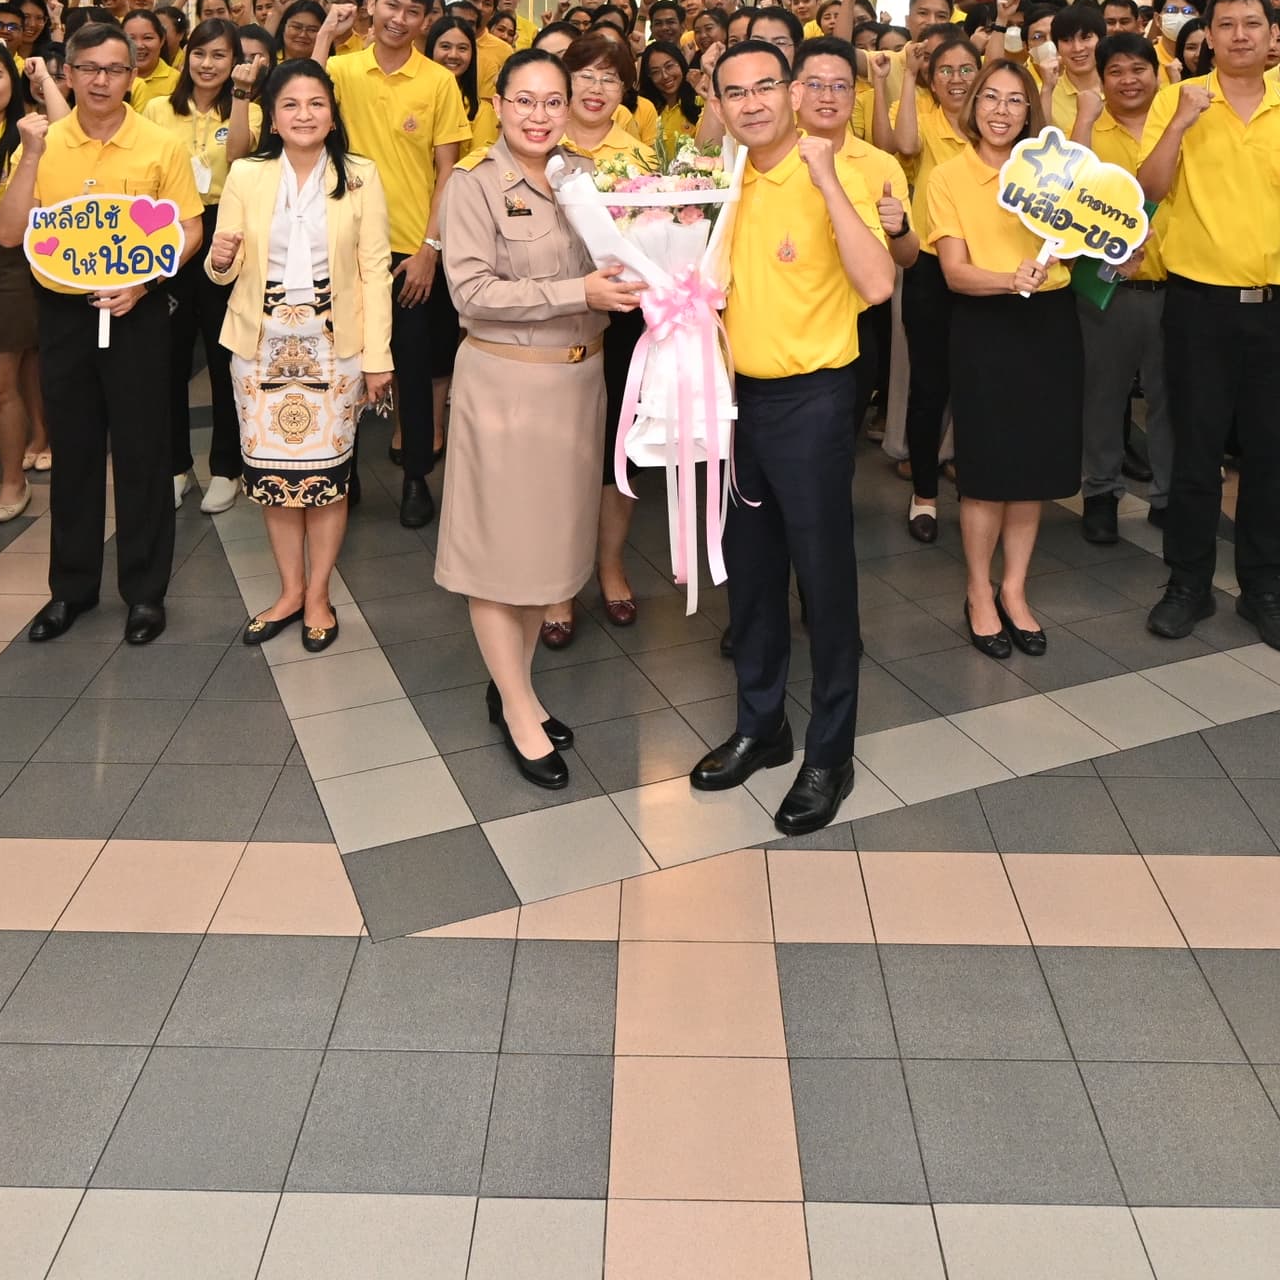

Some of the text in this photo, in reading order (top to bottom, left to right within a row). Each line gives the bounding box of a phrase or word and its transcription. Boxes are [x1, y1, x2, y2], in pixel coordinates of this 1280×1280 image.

[32, 201, 121, 230] เหลือใช้
[1076, 188, 1138, 230] โครงการ
[62, 234, 176, 276] ให้ น้อง
